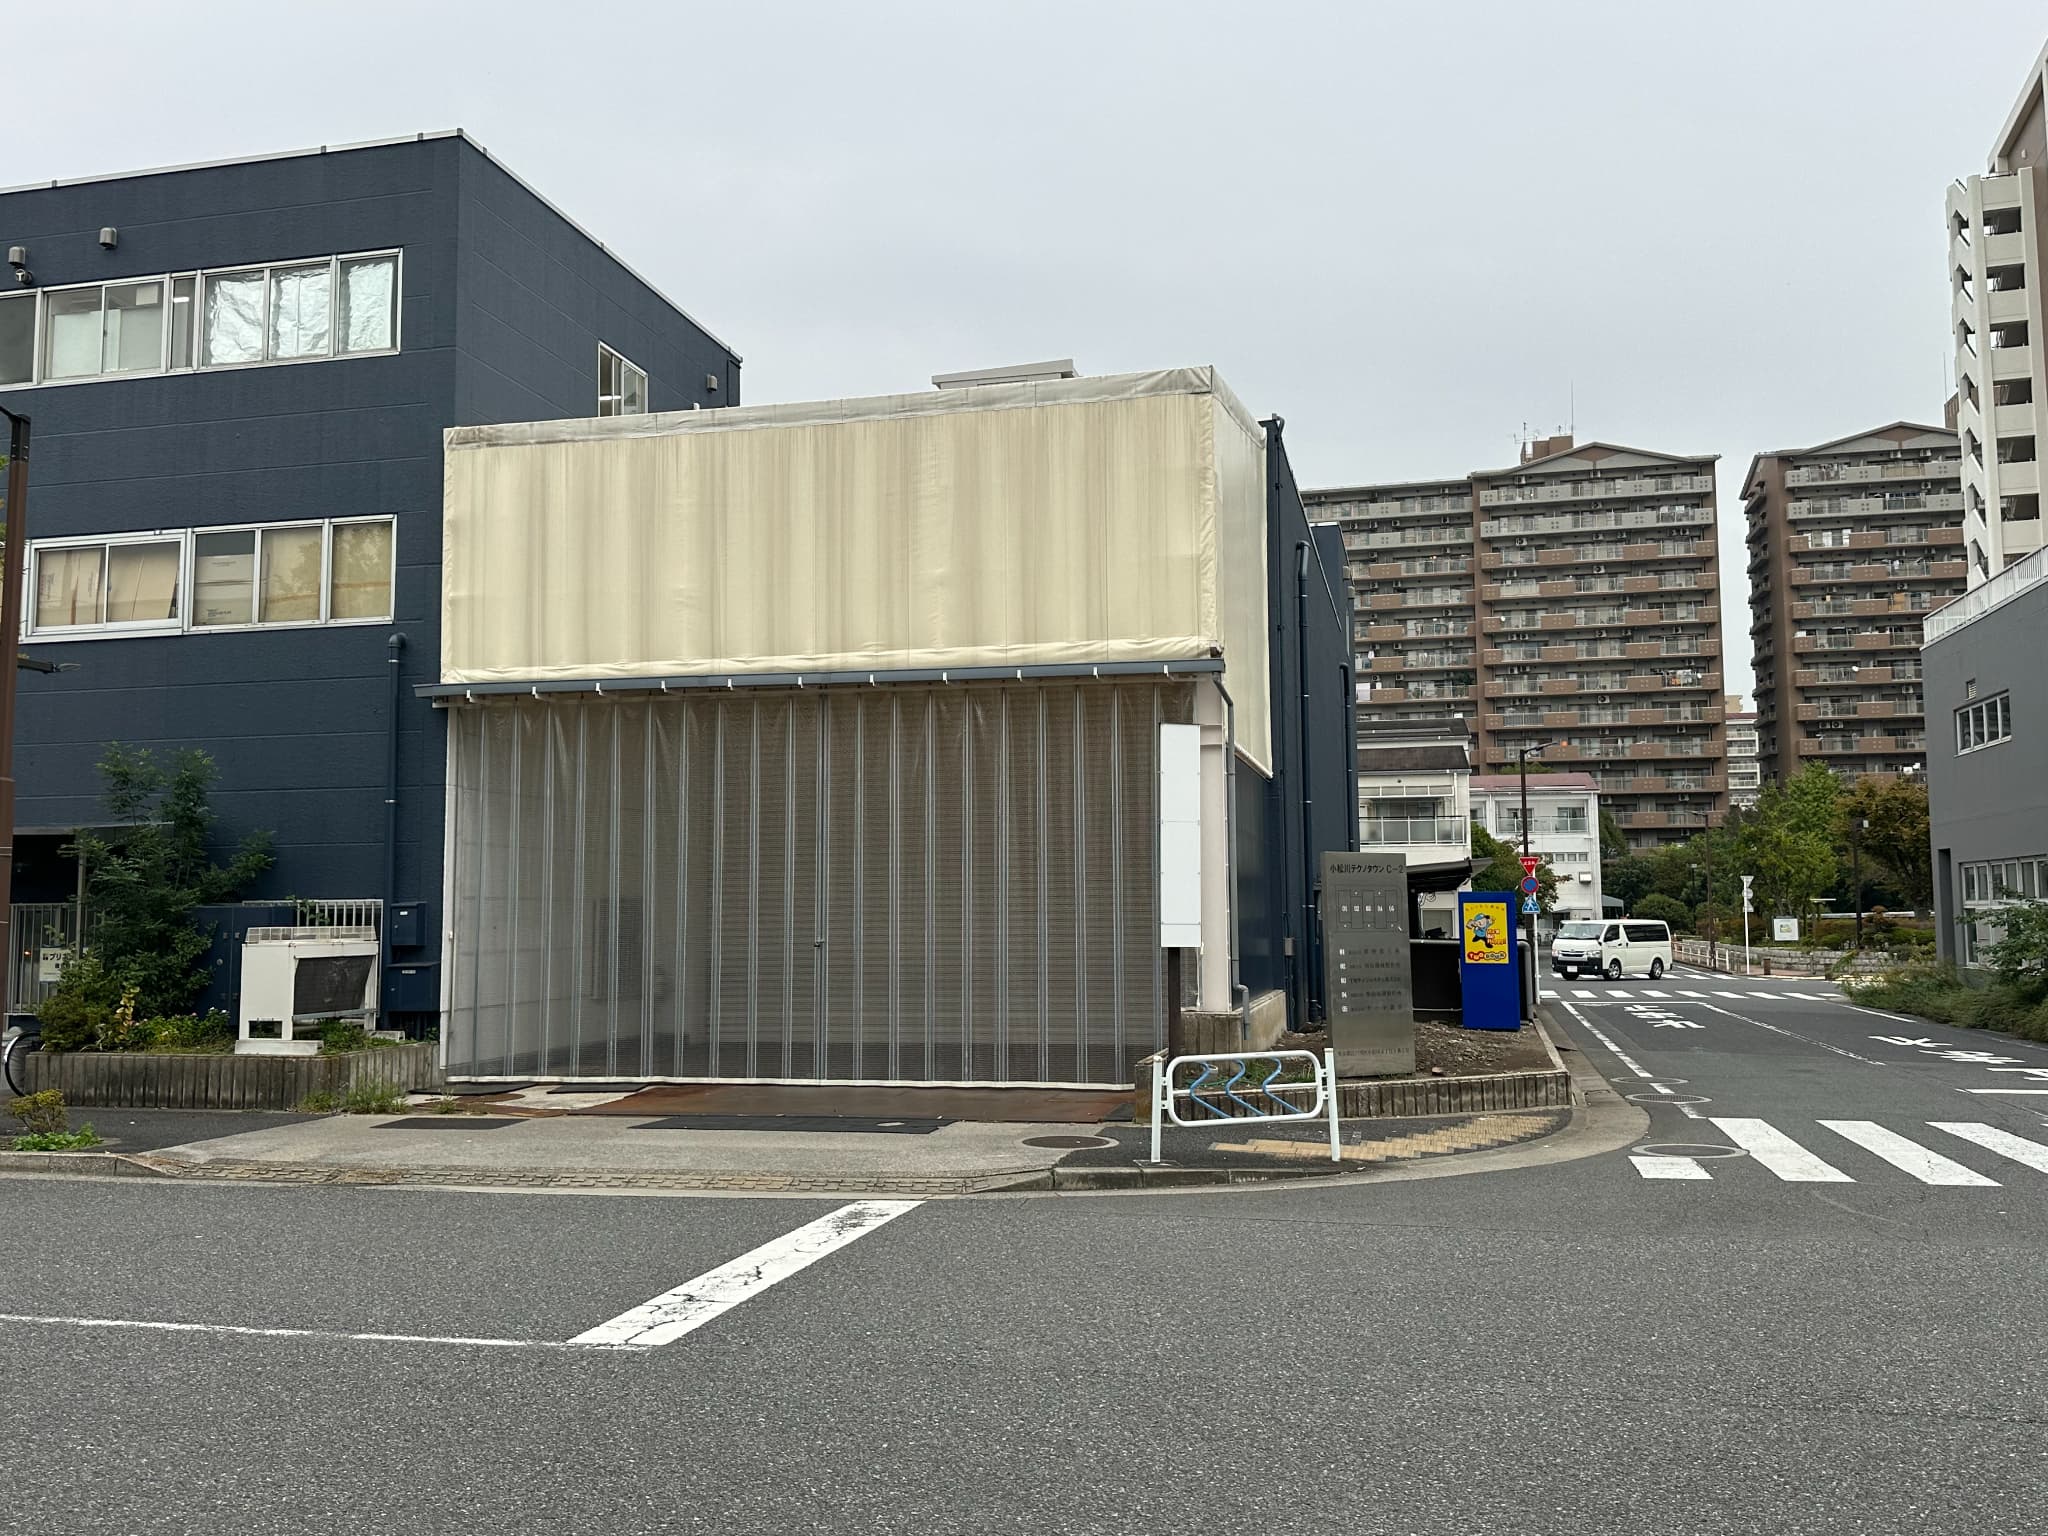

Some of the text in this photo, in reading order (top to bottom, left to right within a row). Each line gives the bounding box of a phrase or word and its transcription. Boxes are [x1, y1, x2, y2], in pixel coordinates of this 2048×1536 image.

[1330, 864, 1384, 873] 小松川テクノタウン
